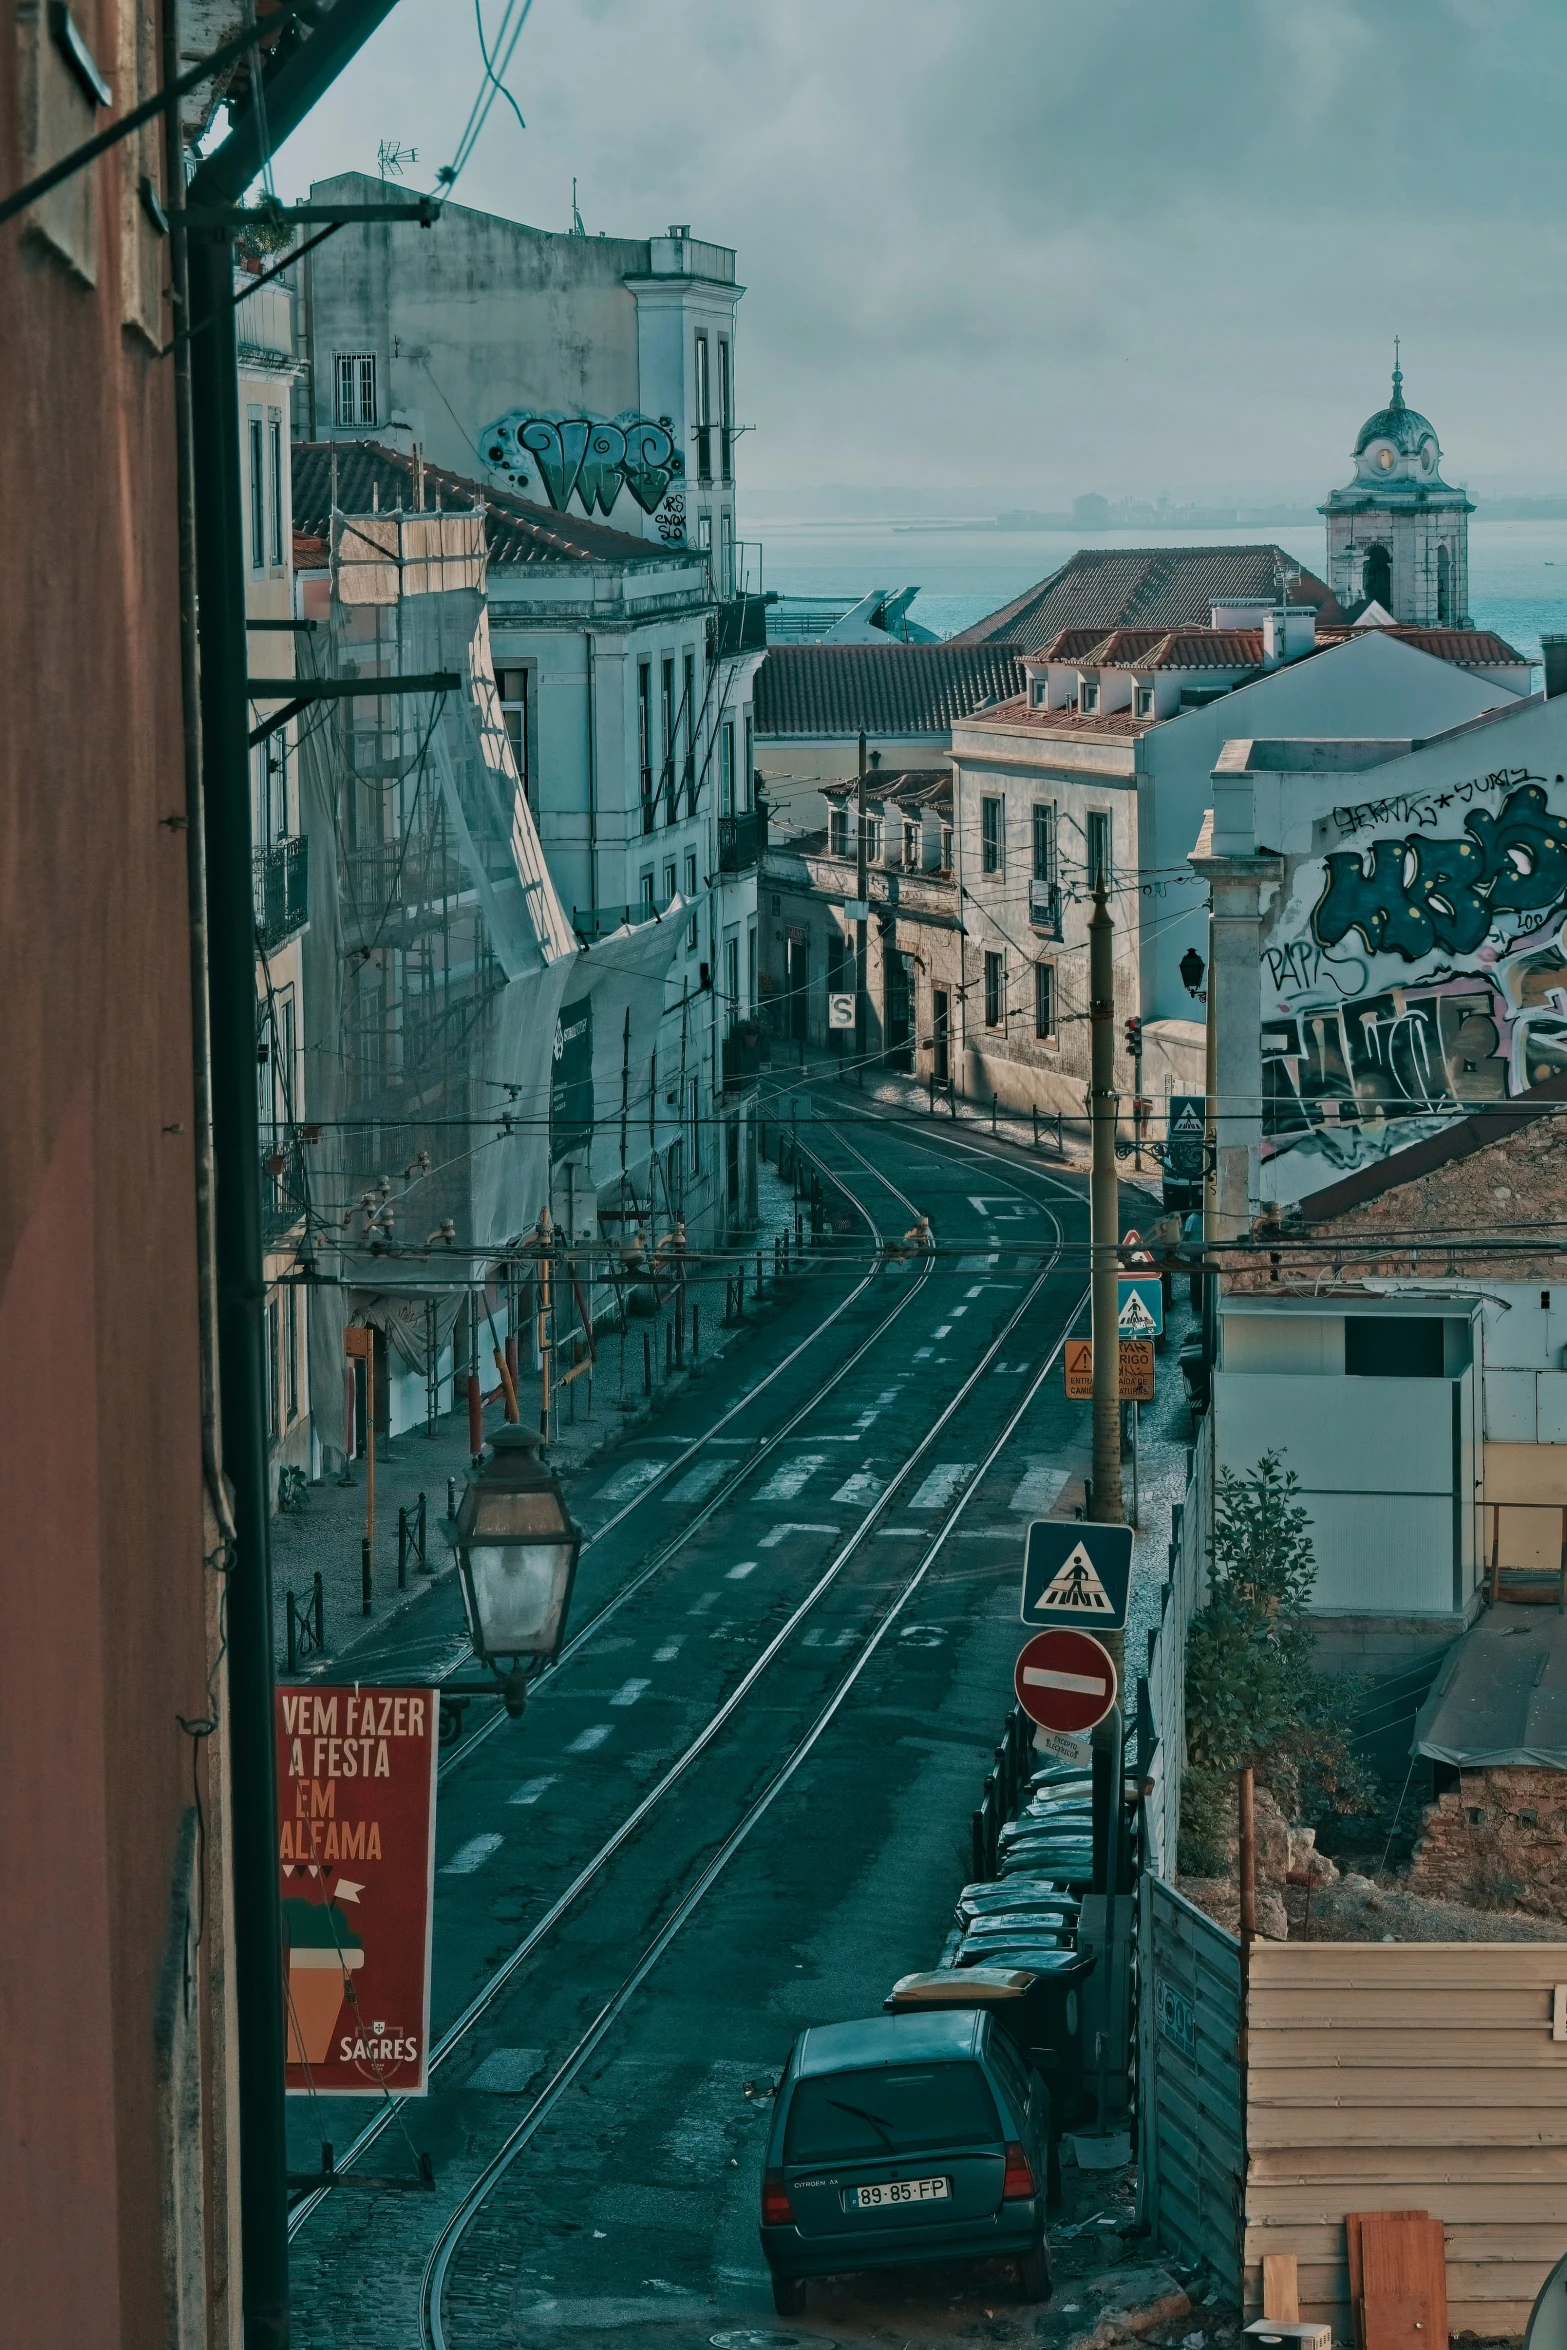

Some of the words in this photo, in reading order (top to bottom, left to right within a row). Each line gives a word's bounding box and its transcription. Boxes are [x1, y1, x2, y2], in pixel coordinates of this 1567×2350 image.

[833, 998, 852, 1024] S
[1119, 1354, 1149, 1365] RIGO
[1070, 1377, 1092, 1385] ENTR
[1119, 1377, 1136, 1385] AÍDA
[1119, 1387, 1148, 1395] ATURAS
[282, 1695, 338, 1735] VEM
[346, 1696, 425, 1737] FAZER
[1054, 1735, 1078, 1750] EXCEPTO
[288, 1737, 305, 1777] A
[313, 1737, 390, 1778] FESTA
[295, 1779, 336, 1818] EM
[280, 1820, 382, 1860] ALFAMA
[339, 2036, 418, 2062] SAGRES
